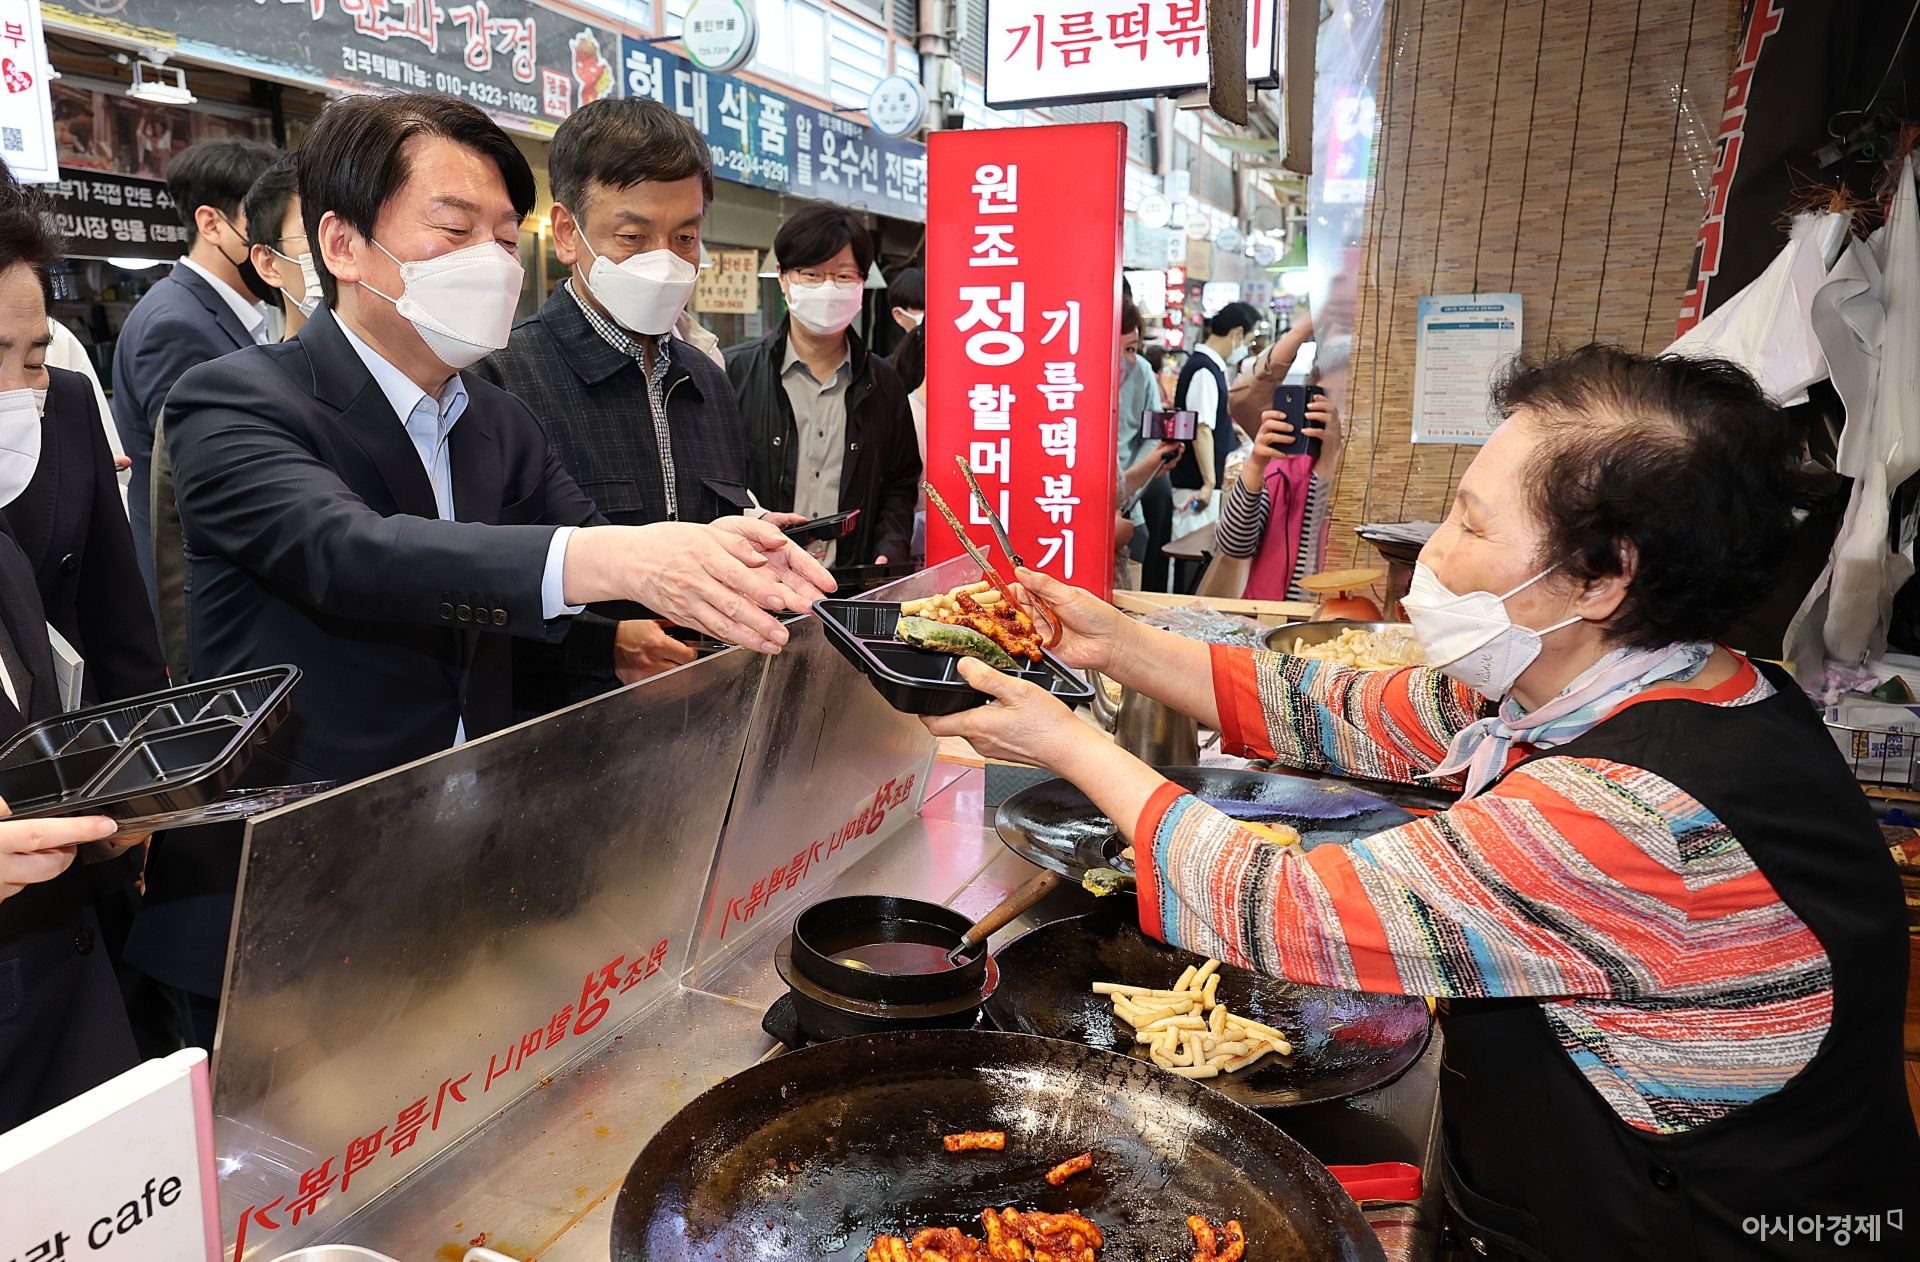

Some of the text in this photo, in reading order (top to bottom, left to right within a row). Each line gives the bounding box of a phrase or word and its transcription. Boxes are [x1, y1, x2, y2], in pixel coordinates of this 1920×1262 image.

[436, 72, 537, 114] 010-4323-1902
[625, 50, 788, 156] 현대식품
[819, 129, 879, 194] 옷수선
[155, 189, 175, 210] 수
[1034, 300, 1085, 579] 기름떡볶기
[88, 1175, 182, 1250] cafe
